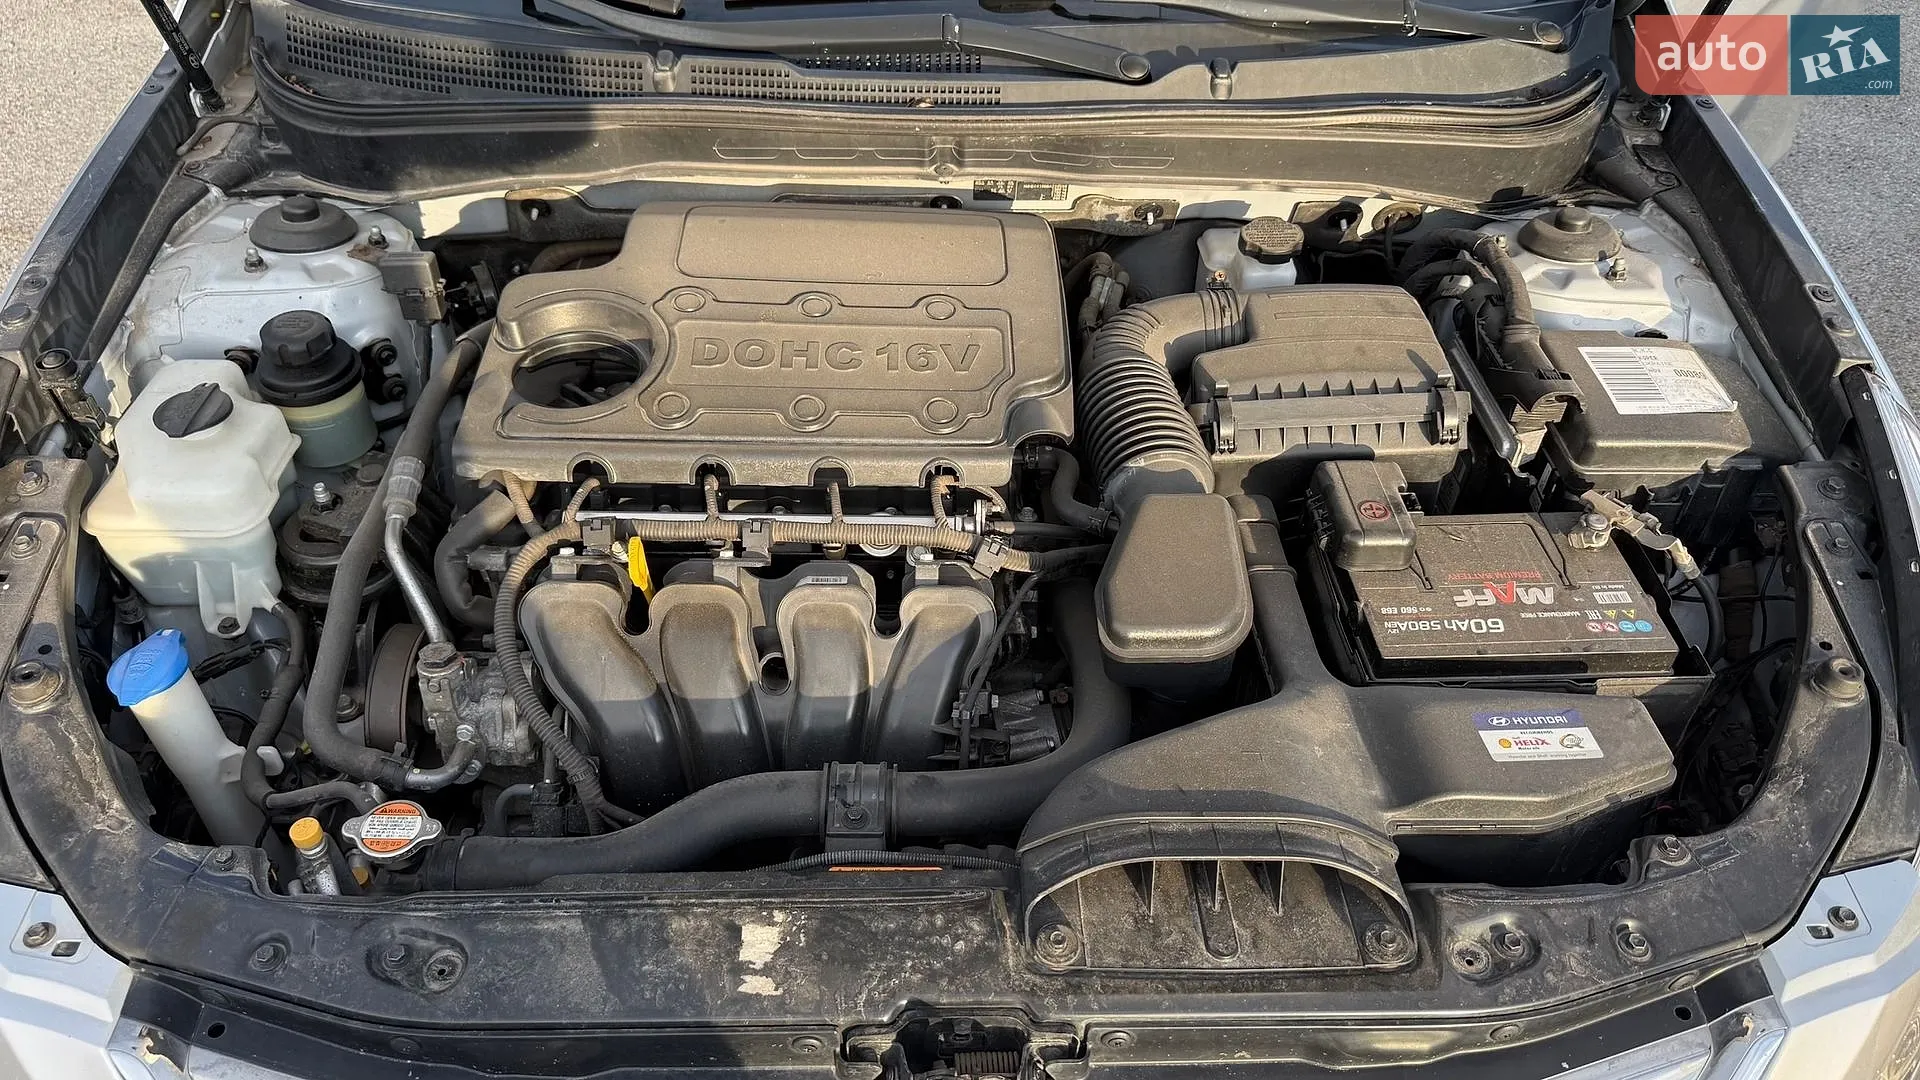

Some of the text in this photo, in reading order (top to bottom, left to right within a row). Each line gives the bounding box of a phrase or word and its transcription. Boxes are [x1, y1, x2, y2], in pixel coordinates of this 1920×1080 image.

[691, 337, 981, 373] DOHC 16V
[1453, 581, 1554, 607] MAFF
[1443, 618, 1505, 634] 60Ah
[1512, 716, 1568, 724] HYUNDAI
